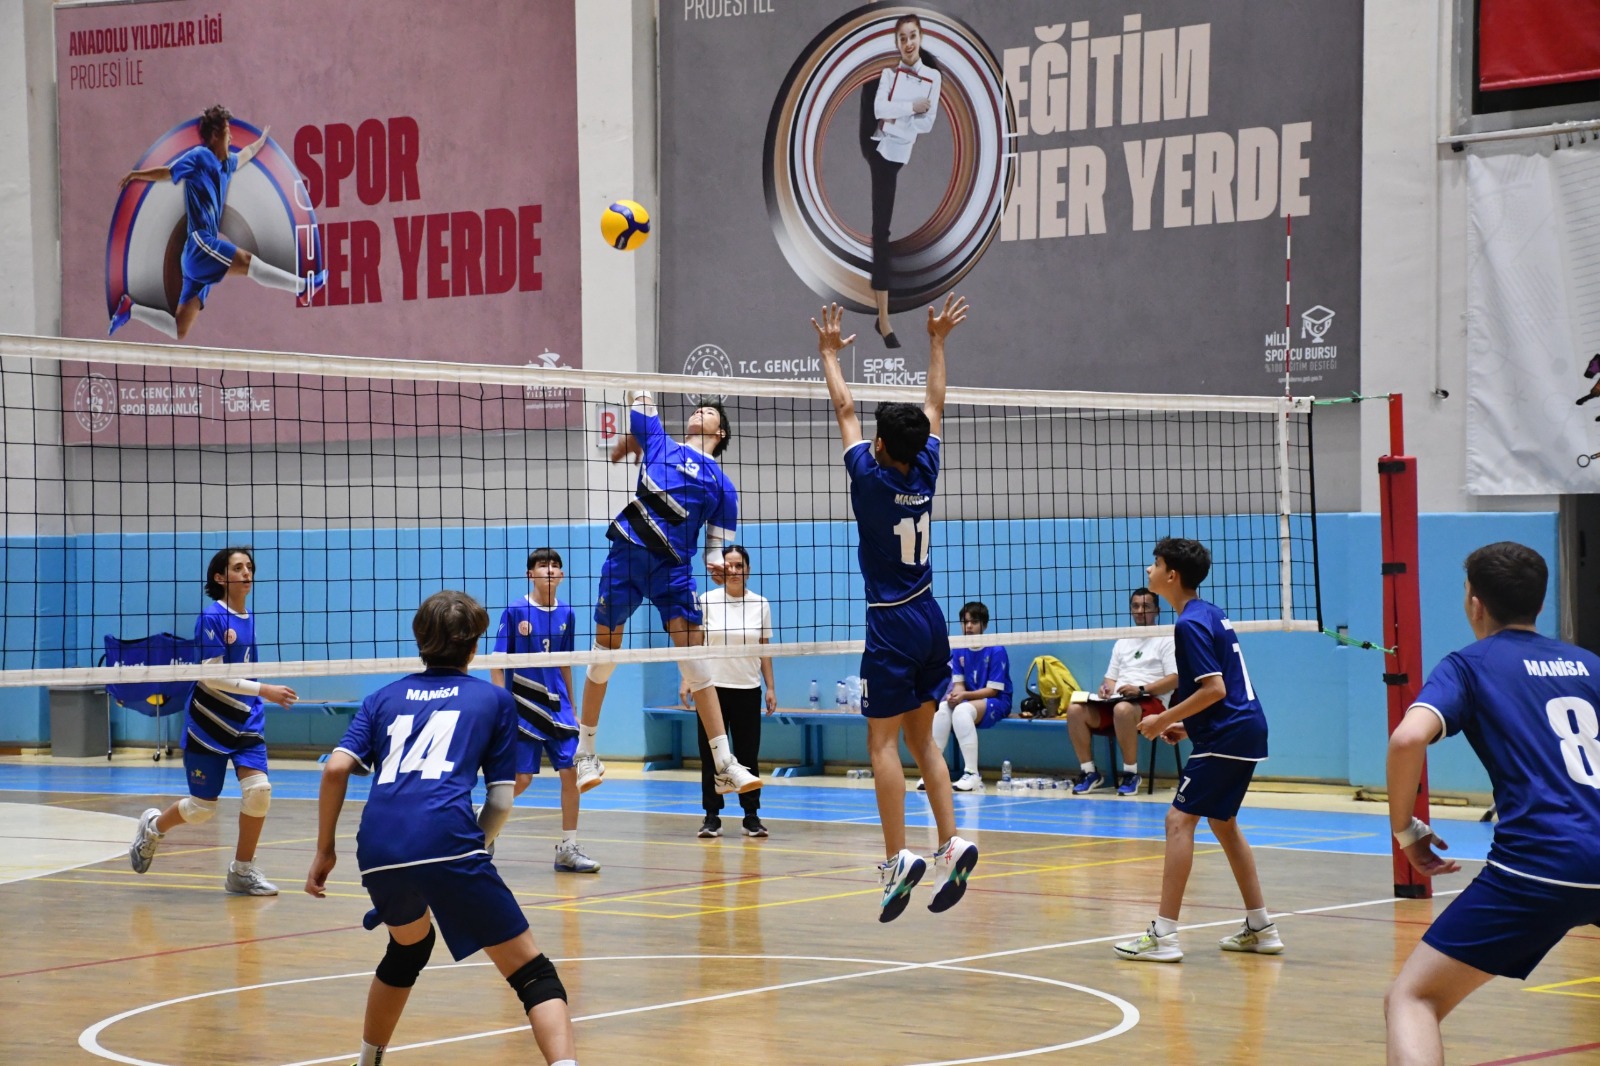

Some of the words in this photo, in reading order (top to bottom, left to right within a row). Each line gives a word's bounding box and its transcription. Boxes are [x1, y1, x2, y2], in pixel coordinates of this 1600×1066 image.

[69, 26, 128, 56] ANADOLU
[131, 20, 195, 51] YILDIZLAR
[198, 13, 223, 45] LİGİ
[70, 58, 122, 90] PROJESİ
[126, 57, 143, 86] İLE
[1001, 13, 1211, 137] EĞİTİM
[294, 116, 421, 211] SPOR
[1000, 145, 1107, 242] HER
[1123, 121, 1312, 231] YERDE
[296, 219, 383, 309] HER
[393, 204, 543, 301] YERDE
[1265, 331, 1289, 346] MİLL
[738, 360, 761, 374] T.C.
[764, 356, 821, 375] GENÇLİK
[1304, 346, 1337, 360] BURSU
[863, 369, 927, 385] TÜRKİYE
[120, 387, 139, 400] T.C.
[141, 385, 186, 402] GENÇLİK
[188, 386, 203, 398] VE
[120, 403, 147, 415] SPOR
[148, 400, 203, 415] BAKANLIĞI
[601, 412, 617, 440] B
[893, 511, 930, 566] 11
[1523, 657, 1590, 677] MANİSA
[405, 686, 459, 701] MANİSA
[377, 710, 461, 785] 14
[1545, 696, 1600, 790] 8
[1179, 775, 1191, 793] 7
